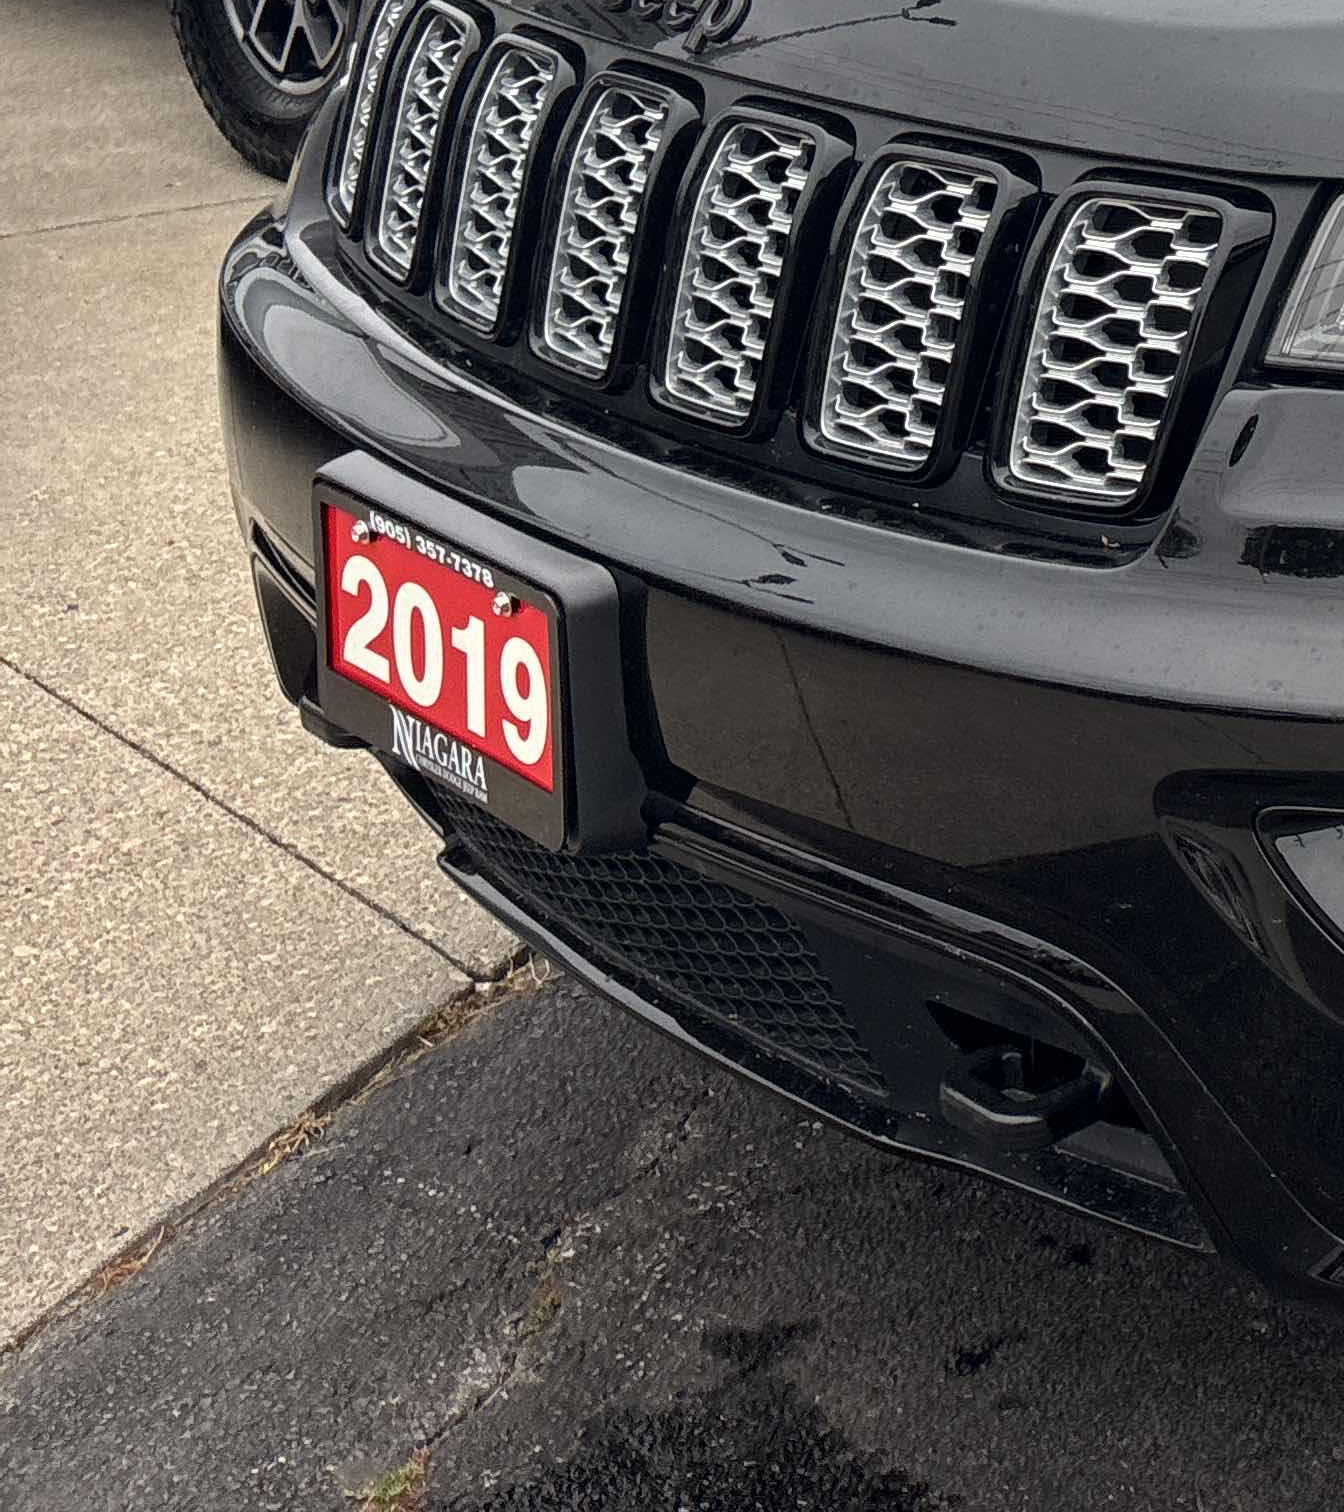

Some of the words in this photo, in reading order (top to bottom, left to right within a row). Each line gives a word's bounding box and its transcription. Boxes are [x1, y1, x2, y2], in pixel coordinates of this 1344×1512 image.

[368, 509, 412, 551] (905)
[415, 534, 495, 591] 357-7378
[341, 554, 548, 766] 2019
[392, 704, 488, 792] NIAGARA
